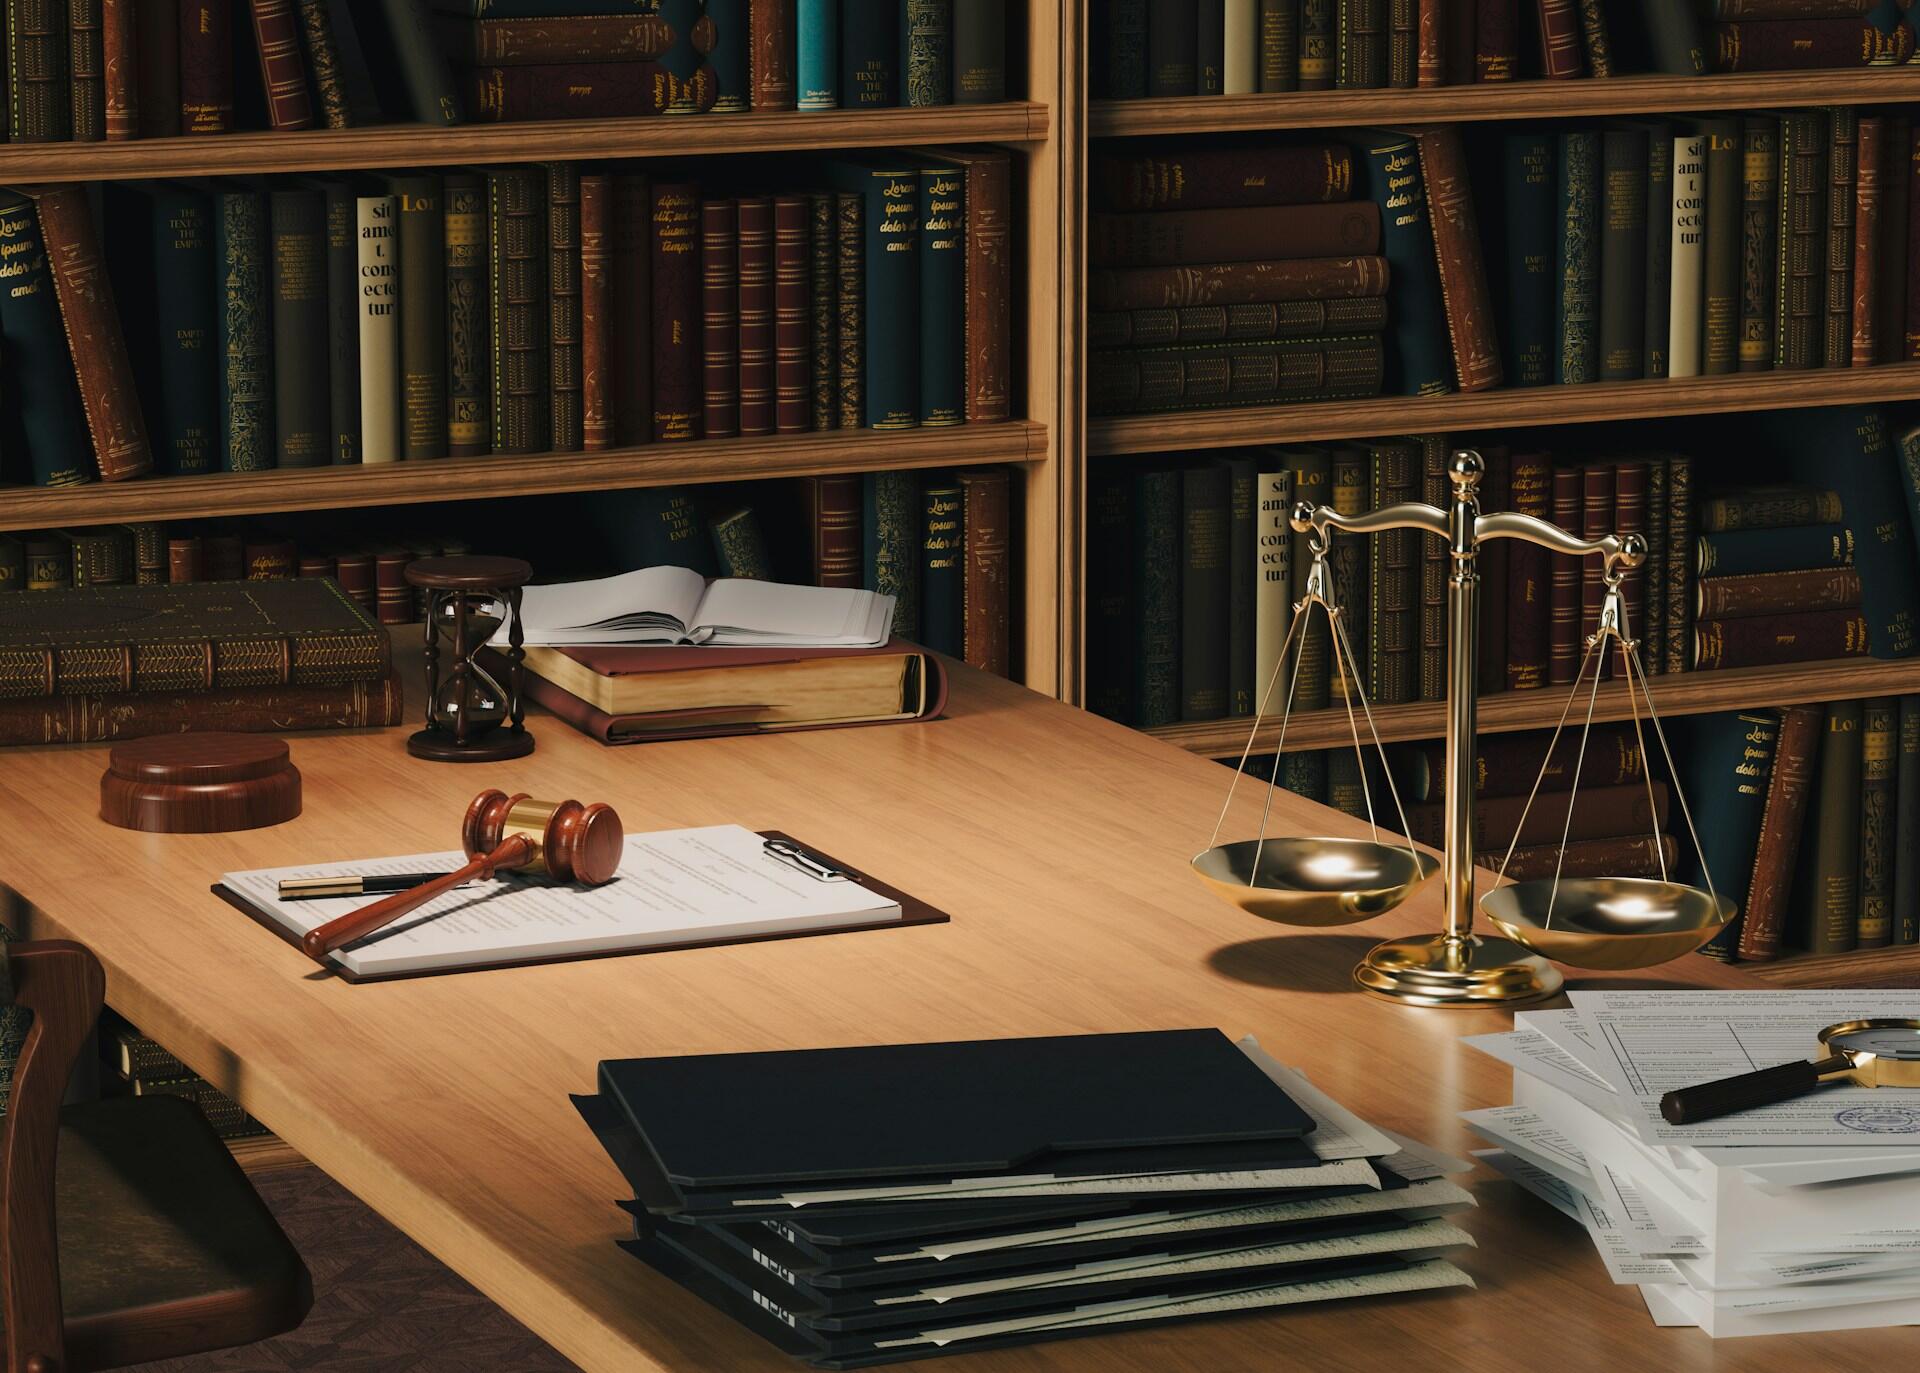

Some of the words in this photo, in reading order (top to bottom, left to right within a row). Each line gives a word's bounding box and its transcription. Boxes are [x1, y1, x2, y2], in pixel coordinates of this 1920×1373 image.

[1687, 142, 1704, 156] sit
[1385, 154, 1415, 172] Lorem
[883, 179, 915, 198] Lorem
[929, 177, 960, 196] Lorem
[1388, 175, 1416, 192] ipsum
[930, 199, 959, 215] ipsum
[1386, 193, 1412, 209] dolor
[372, 202, 391, 219] sit
[885, 202, 914, 217] ipsum
[880, 219, 907, 233] dolor
[925, 216, 952, 231] dolor
[1680, 232, 1702, 244] tur
[1, 240, 34, 260] ipsum
[368, 302, 394, 316] tur
[1272, 478, 1289, 493] sit
[928, 498, 960, 516] Lorem
[929, 520, 957, 534] ipsum
[1266, 569, 1288, 582] tur
[1746, 725, 1774, 743] Lorem
